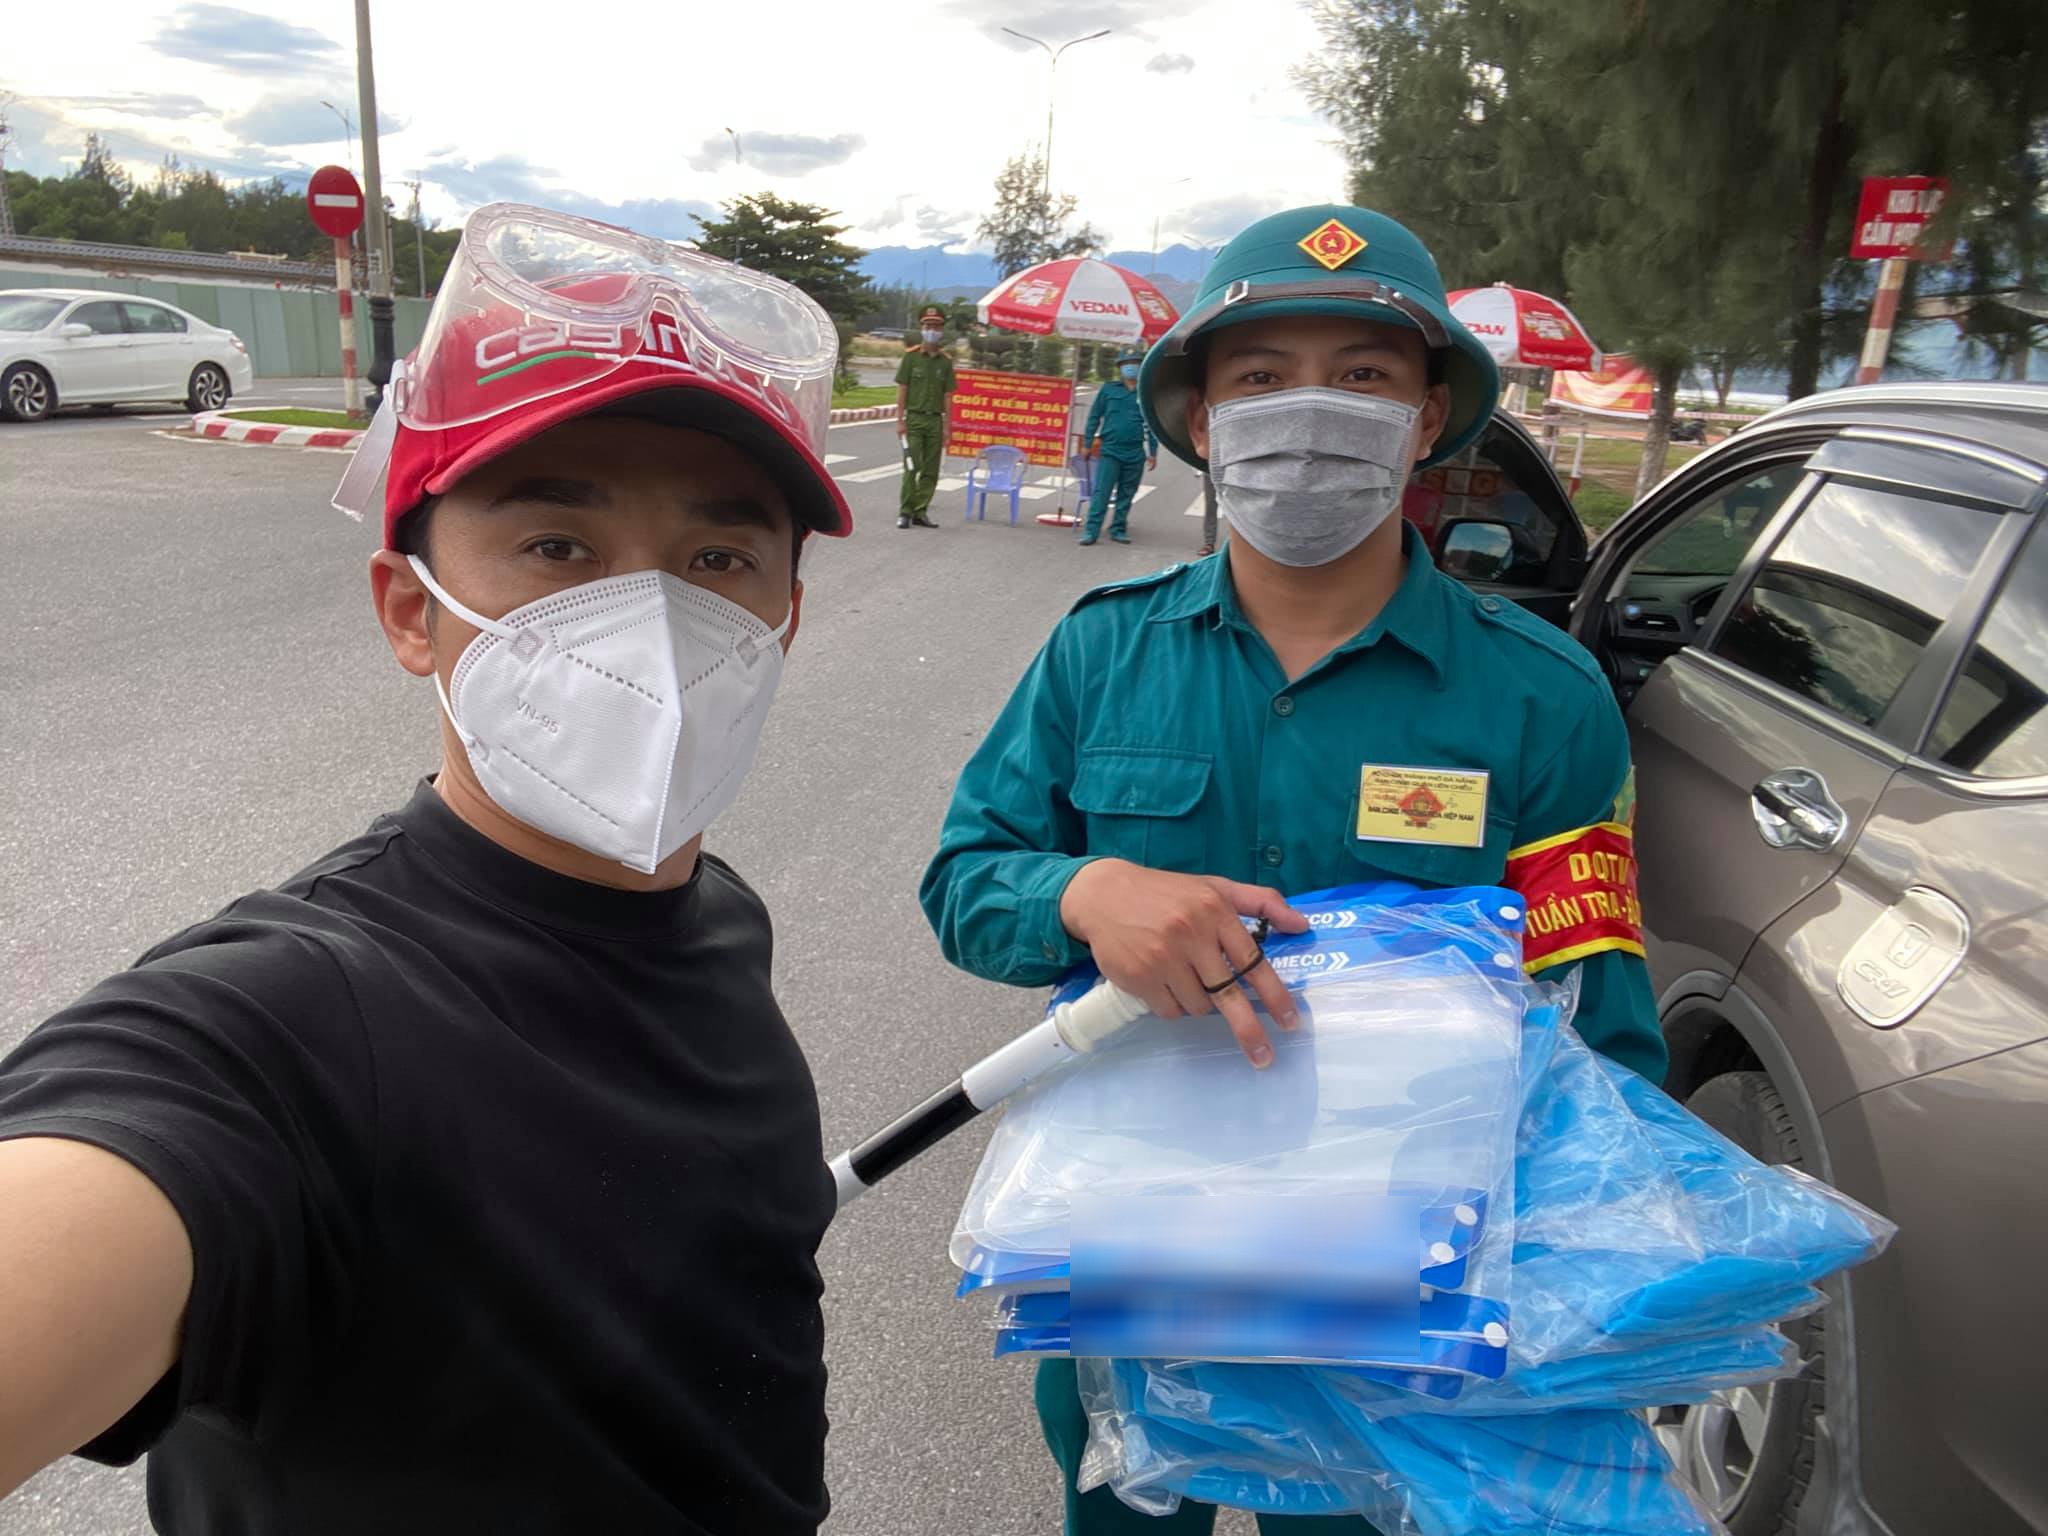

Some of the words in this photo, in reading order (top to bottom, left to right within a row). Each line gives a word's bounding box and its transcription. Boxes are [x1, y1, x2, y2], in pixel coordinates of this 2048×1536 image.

[1069, 300, 1128, 316] VEDAN
[952, 394, 988, 406] CHỐT
[961, 409, 994, 421] DỊCH
[998, 412, 1063, 427] COVID-19
